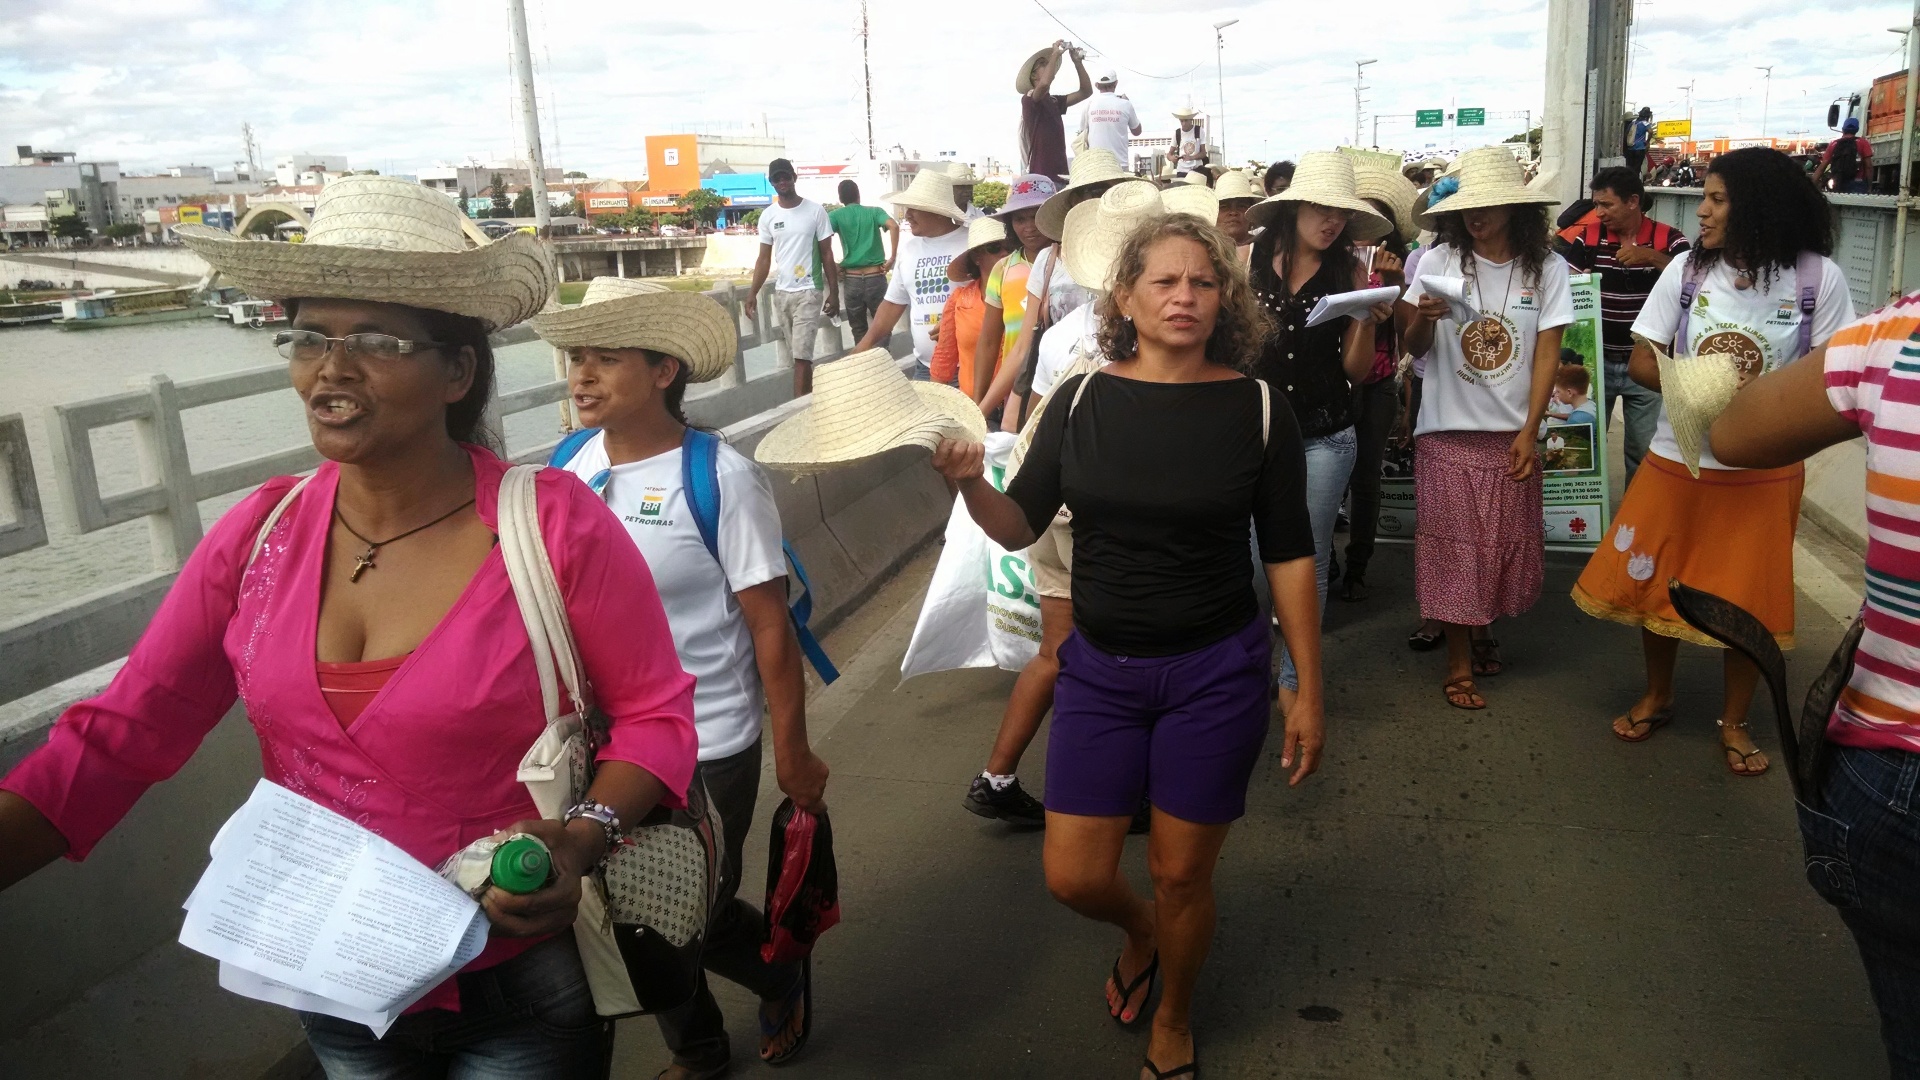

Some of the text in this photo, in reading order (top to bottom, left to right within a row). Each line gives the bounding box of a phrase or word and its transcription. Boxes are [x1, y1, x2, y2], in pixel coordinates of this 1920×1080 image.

[917, 255, 952, 268] ESPORTE
[915, 269, 920, 279] E
[1692, 332, 1703, 351] CUIDAR
[1743, 326, 1771, 352] ALIMENTAR
[642, 502, 658, 511] BR
[624, 516, 674, 526] PETROBRAS
